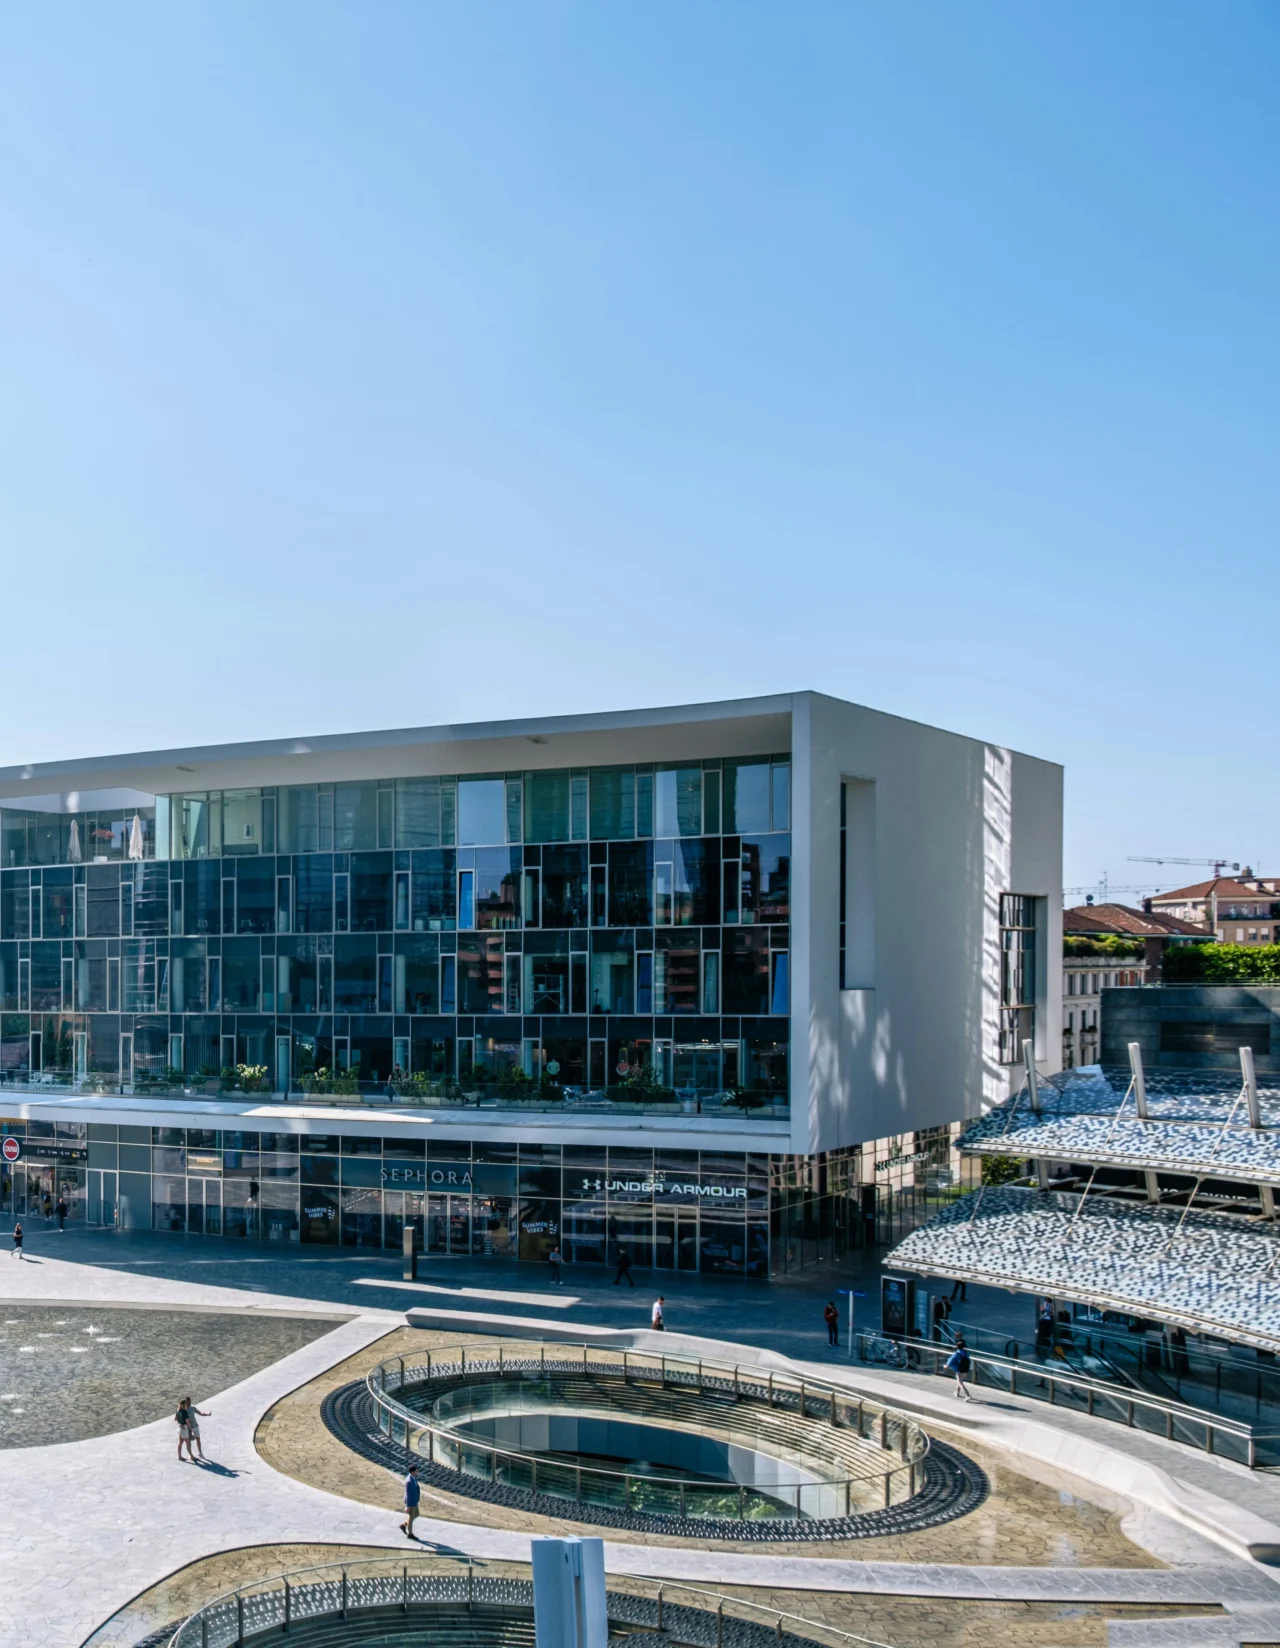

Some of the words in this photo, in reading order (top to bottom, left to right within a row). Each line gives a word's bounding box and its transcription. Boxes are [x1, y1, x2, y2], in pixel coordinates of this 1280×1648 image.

[380, 1167, 473, 1185] SEPHORA
[604, 1180, 664, 1193] UNDER
[670, 1183, 748, 1198] ARMOUR
[521, 1221, 548, 1229] SUMMER
